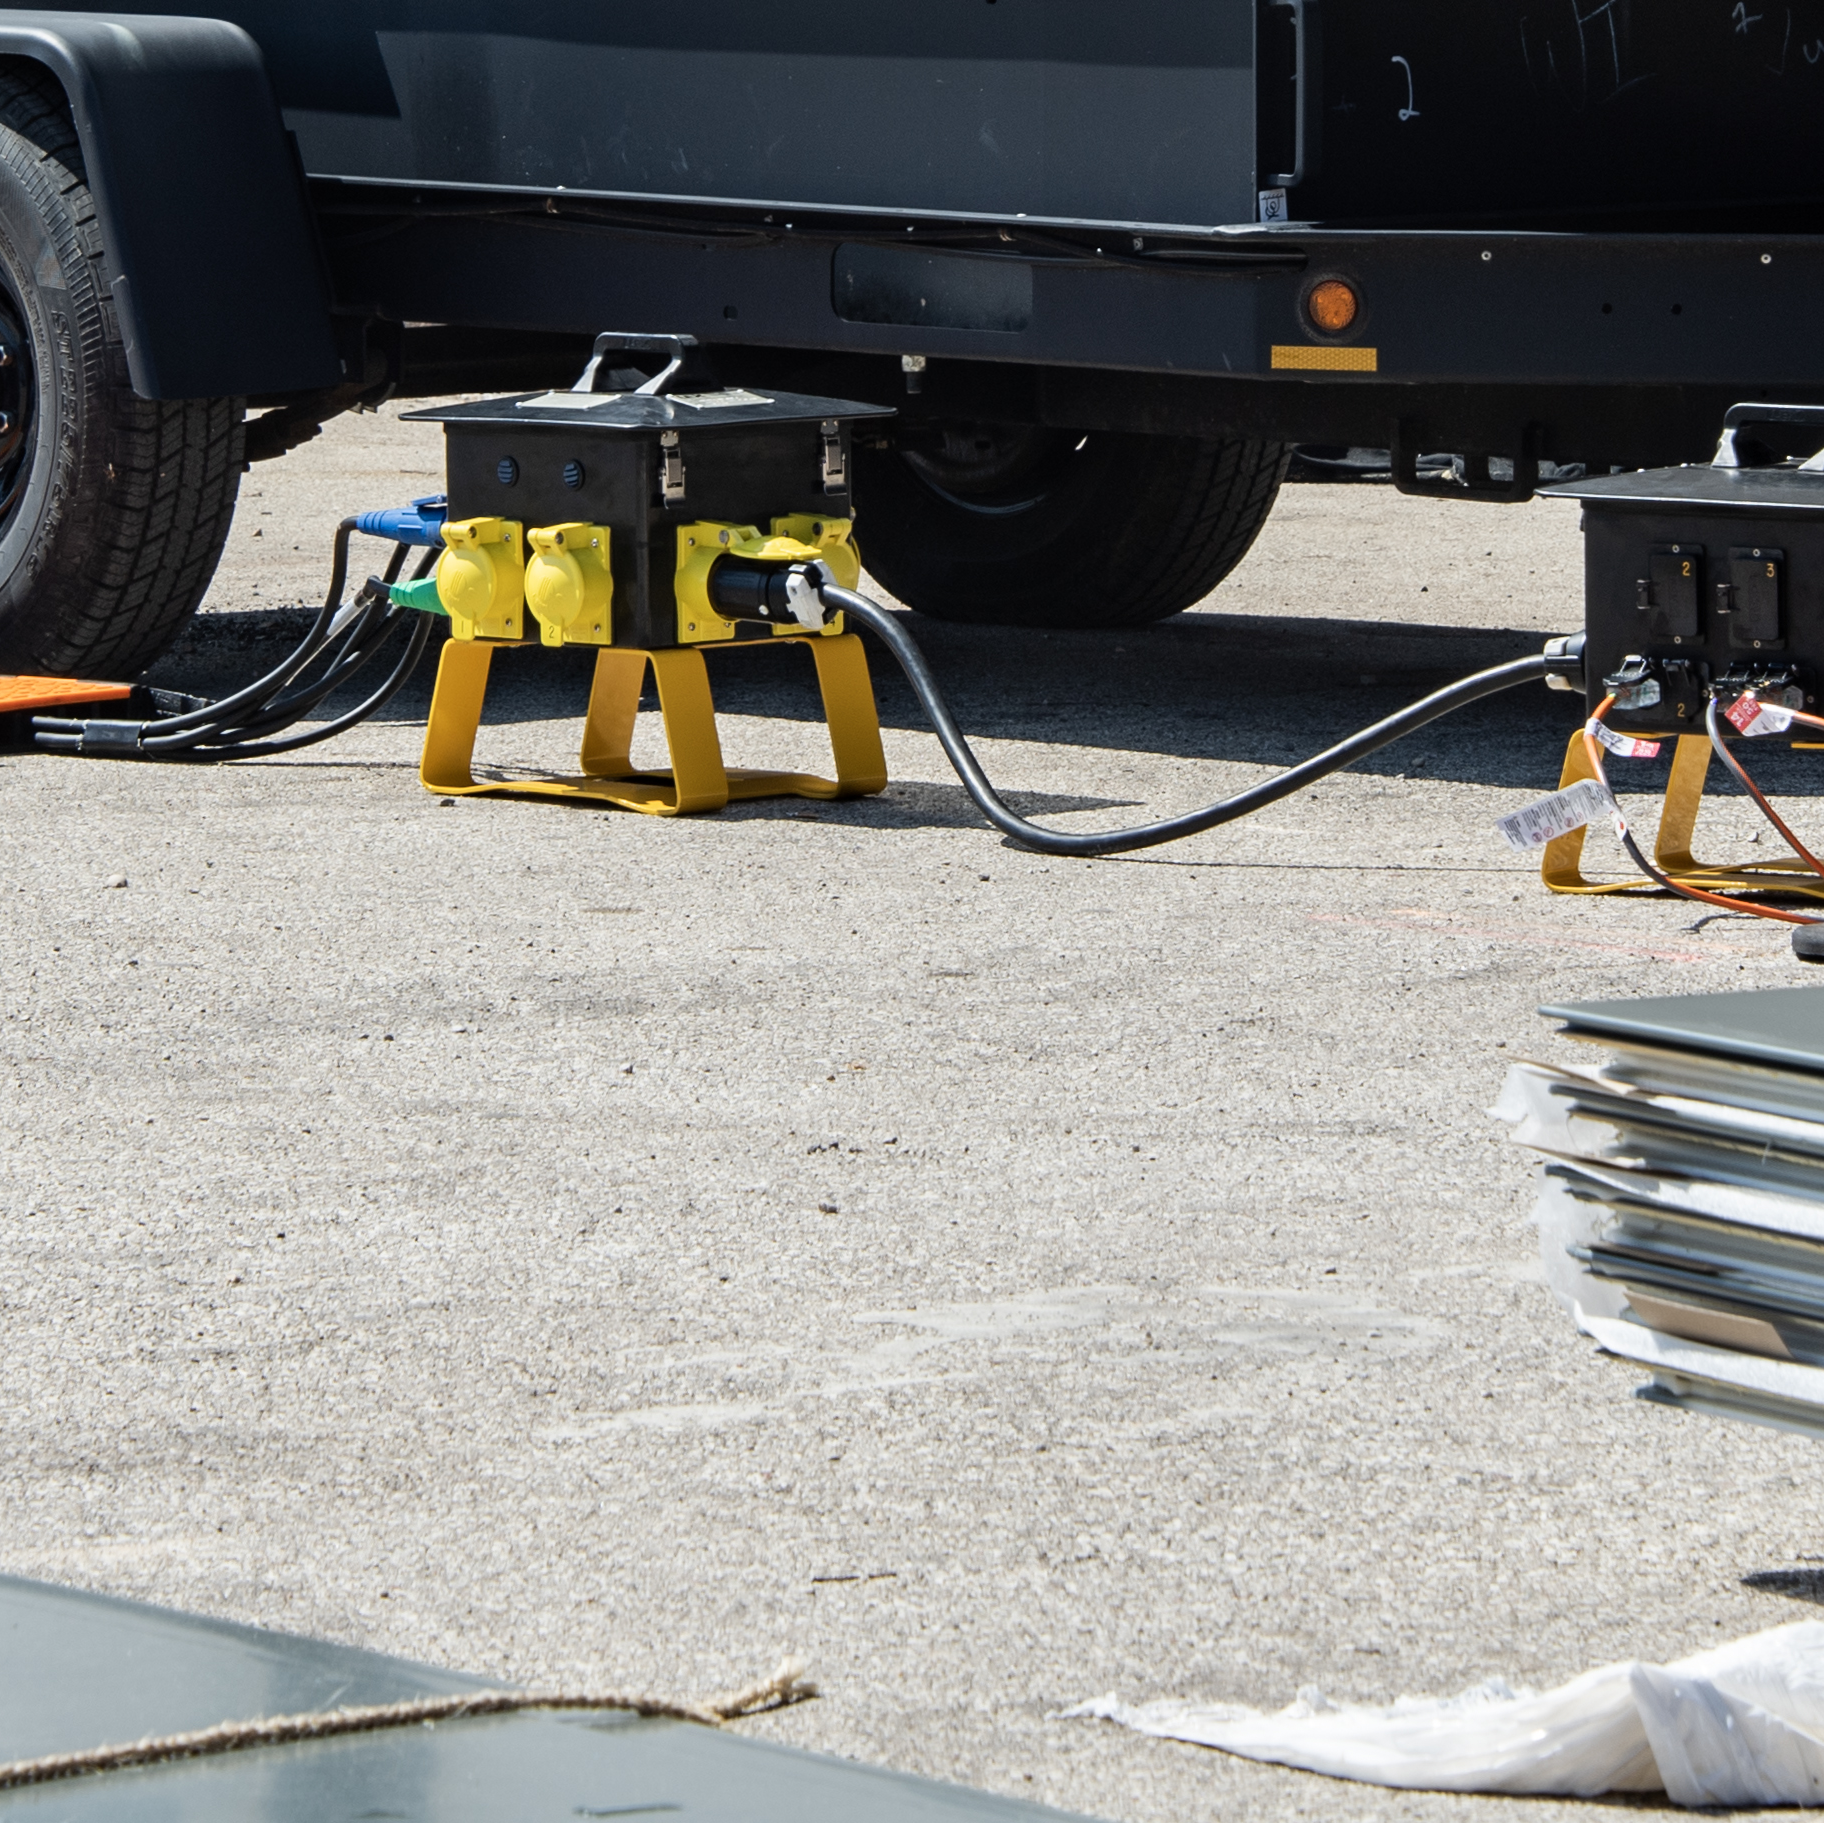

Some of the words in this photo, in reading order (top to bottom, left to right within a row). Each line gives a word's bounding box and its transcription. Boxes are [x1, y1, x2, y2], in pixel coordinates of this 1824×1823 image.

[1682, 561, 1691, 577] 2
[1766, 562, 1775, 578] 3
[548, 625, 555, 639] 2
[1677, 702, 1686, 718] 2
